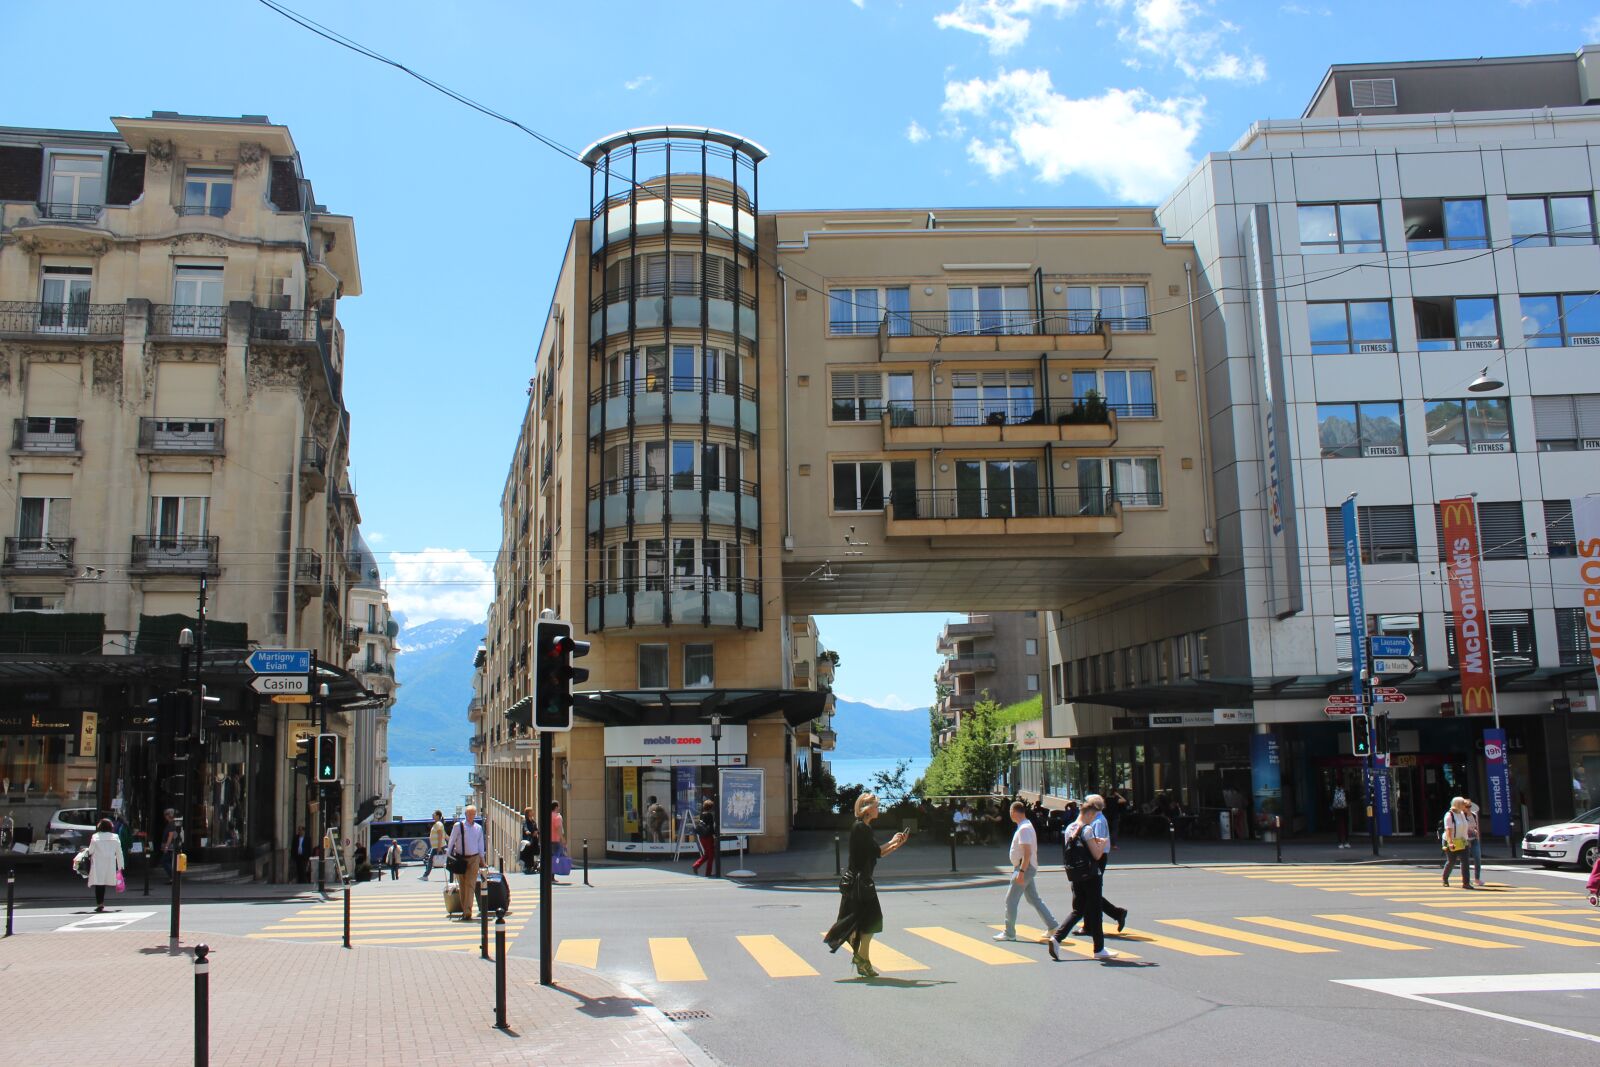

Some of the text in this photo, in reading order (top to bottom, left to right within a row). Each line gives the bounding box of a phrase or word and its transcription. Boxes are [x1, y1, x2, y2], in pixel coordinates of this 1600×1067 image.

[1466, 340, 1492, 349] FITNESS
[1573, 336, 1600, 346] FITNESS
[1360, 343, 1387, 352] FITNESS
[1370, 446, 1397, 455] FITNESS
[1477, 443, 1504, 452] FITNESS
[1453, 537, 1483, 674] McDonald's
[258, 653, 294, 662] Martigny
[265, 662, 287, 670] Evian
[263, 678, 303, 690] Casino
[643, 736, 702, 745] mobilezone
[1379, 775, 1389, 814] samedi
[1490, 775, 1502, 814] samedi
